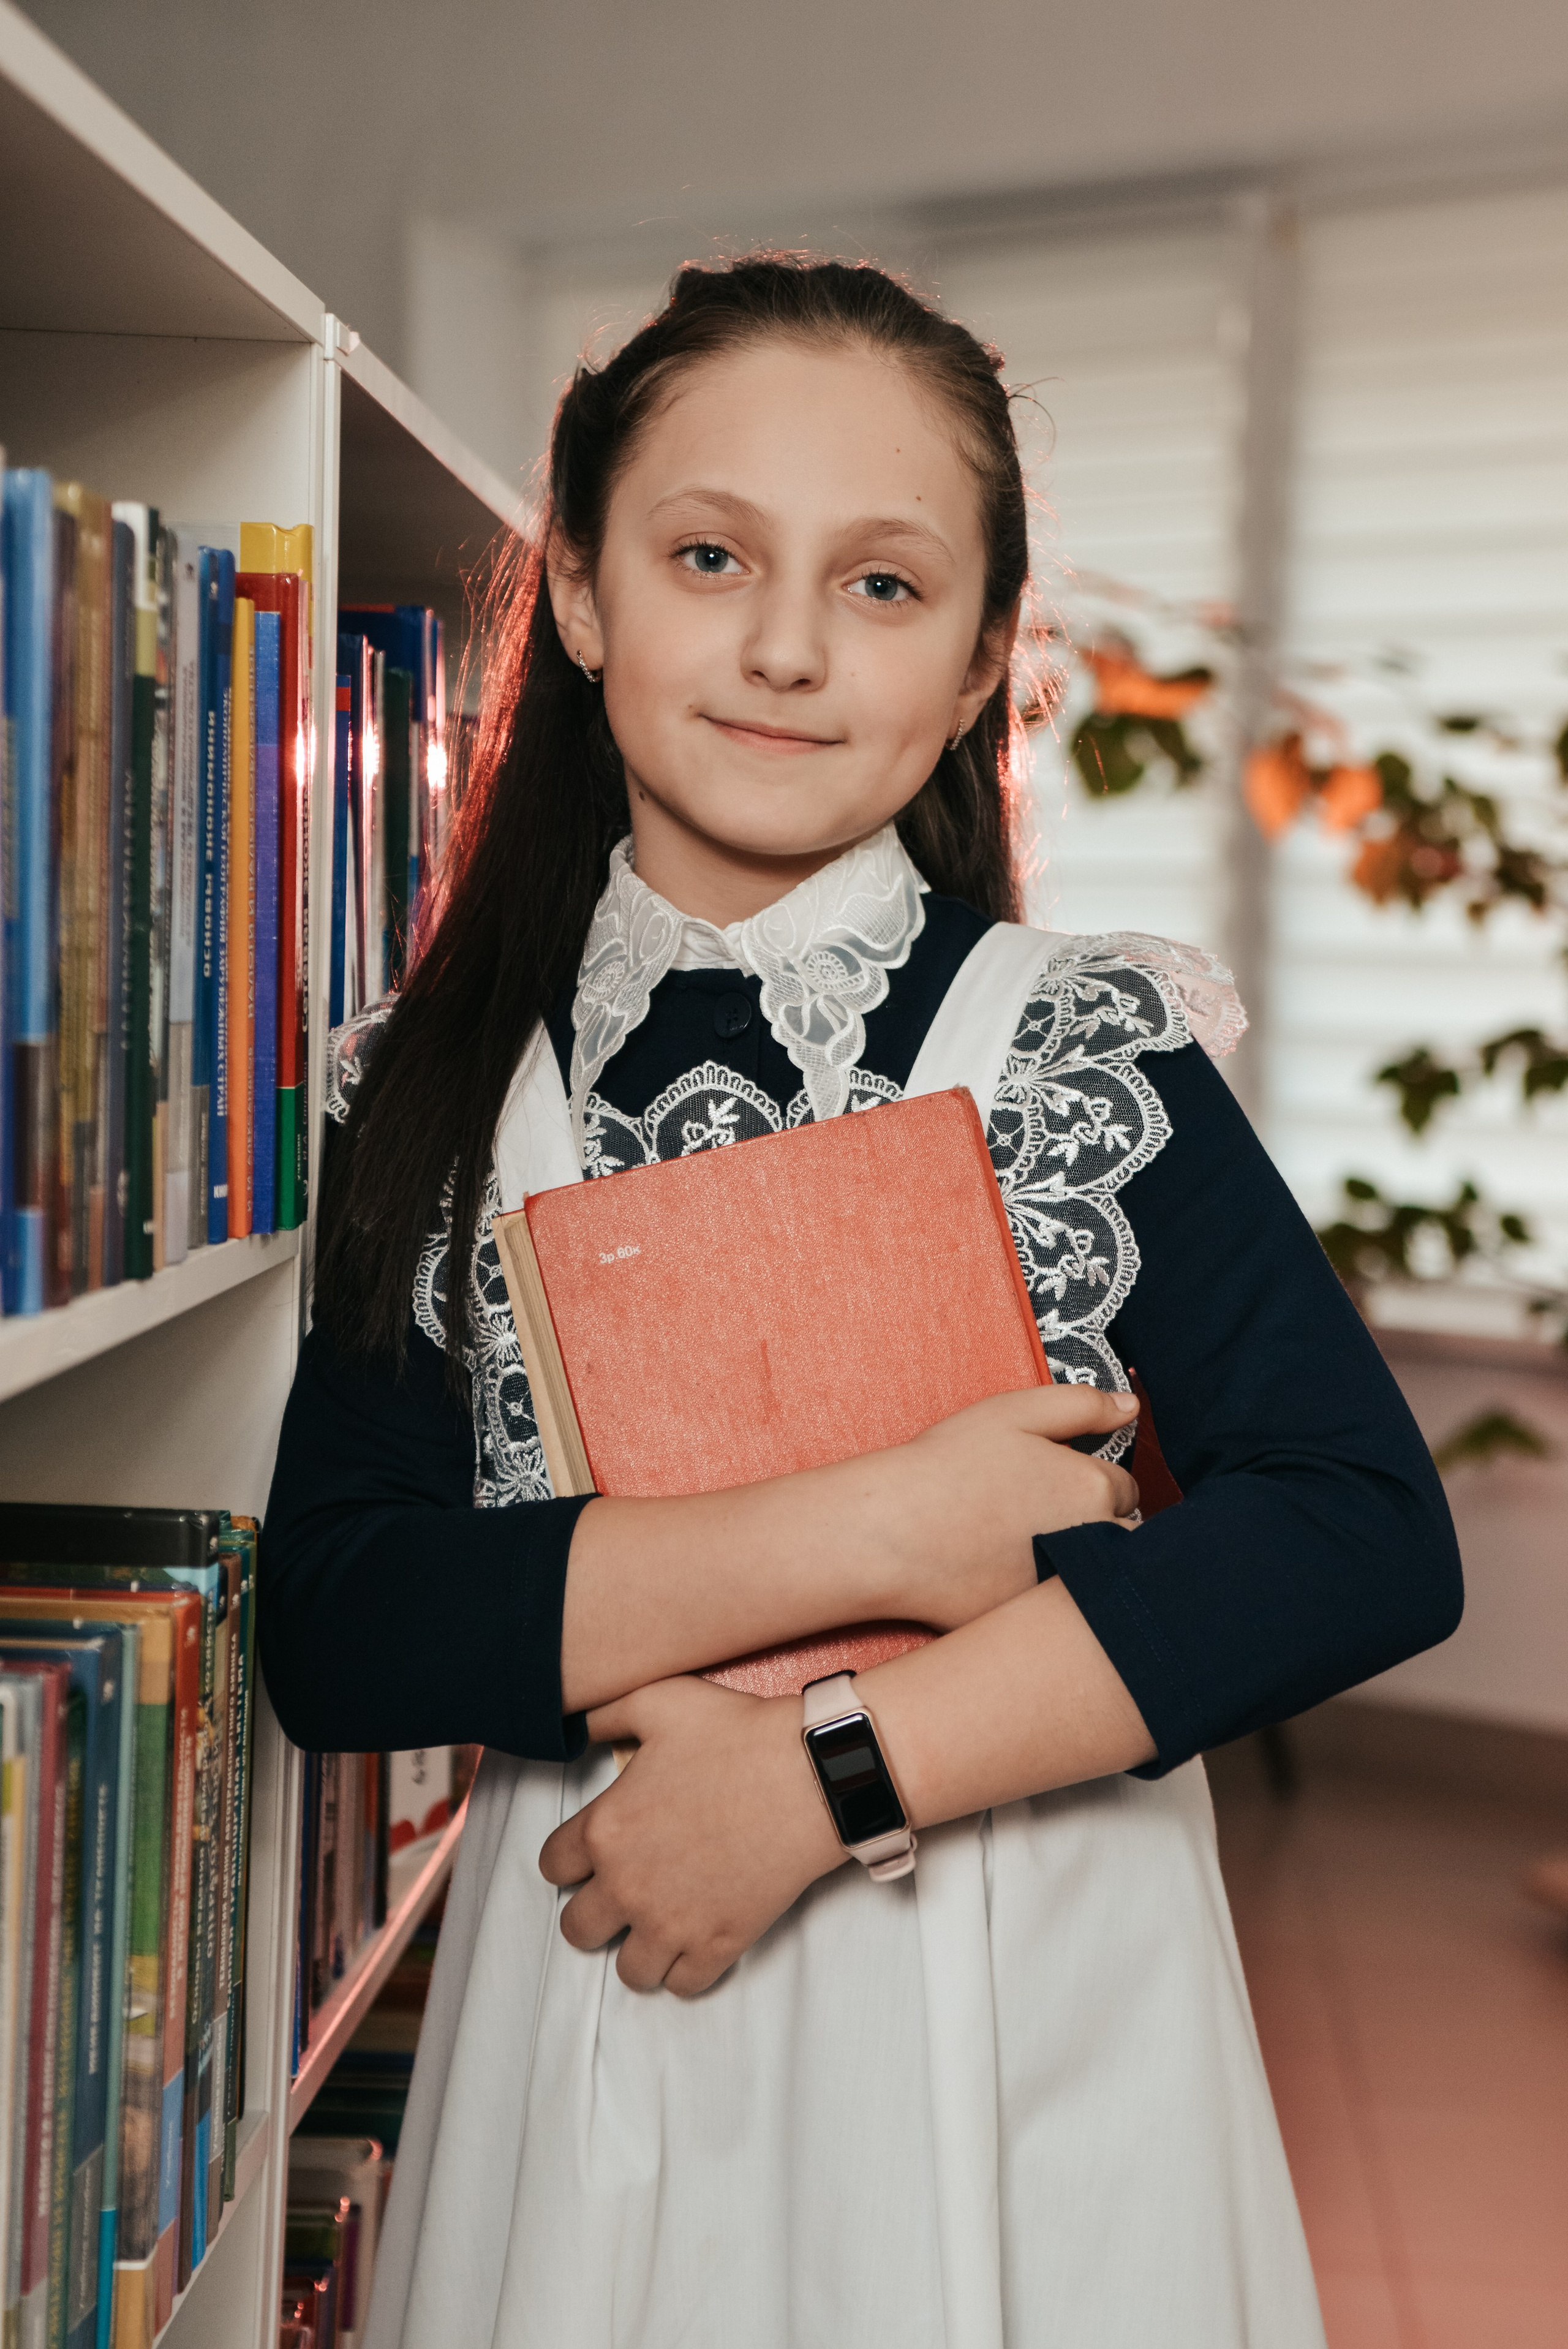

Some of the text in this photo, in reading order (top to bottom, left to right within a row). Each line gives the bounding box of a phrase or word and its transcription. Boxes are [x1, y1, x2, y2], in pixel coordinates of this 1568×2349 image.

[203, 710, 215, 977] ОСНОВЫ ЭКОНОМИКИ
[247, 899, 254, 914] И
[216, 1063, 225, 1117] СТРАН
[235, 1653, 244, 1745] СИСТЕМА
[225, 1696, 234, 1840] АВТОТРАНСПОРТНОГО
